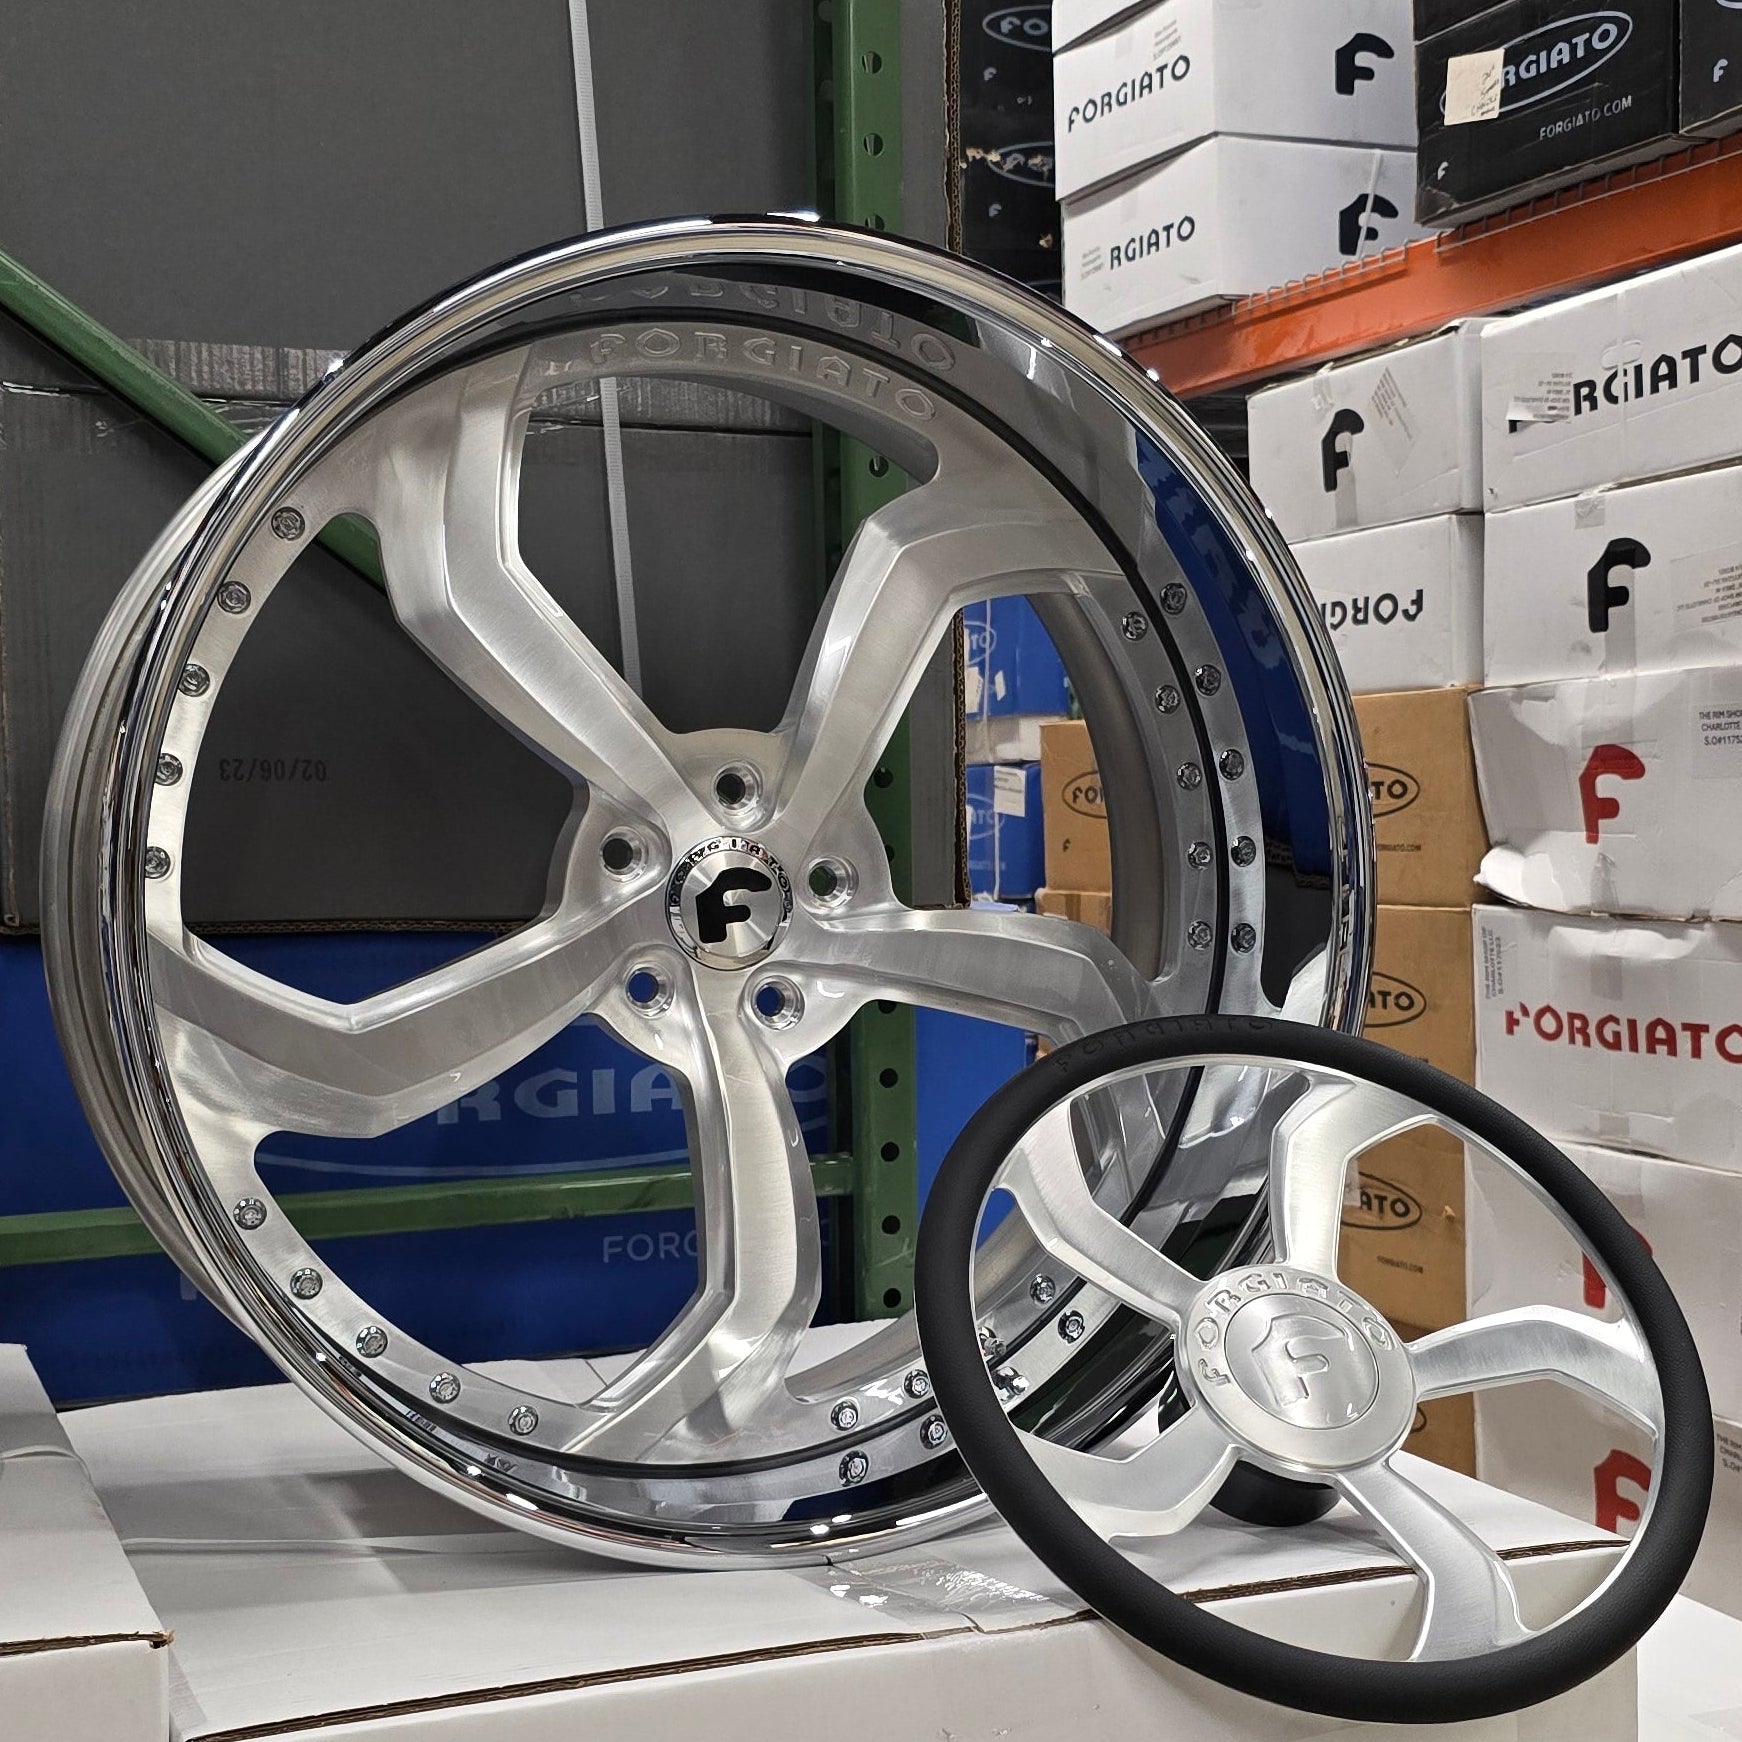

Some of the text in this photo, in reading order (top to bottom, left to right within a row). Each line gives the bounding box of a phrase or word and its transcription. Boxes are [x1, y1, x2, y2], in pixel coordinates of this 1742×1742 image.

[1067, 54, 1191, 133] FORGIATO
[1334, 32, 1395, 96] F
[1712, 58, 1729, 83] F
[1538, 95, 1633, 141] FORGIATOCOM
[1109, 215, 1196, 270] RGIATO
[1338, 193, 1400, 256] F
[589, 327, 937, 421] FORGIATO
[1509, 334, 1742, 434] RGIATO
[1321, 408, 1365, 493] F
[1587, 537, 1652, 633] F
[1579, 744, 1646, 845] F
[695, 866, 772, 944] F
[1194, 1272, 1397, 1387] FORGIATO
[1251, 1313, 1351, 1407] F
